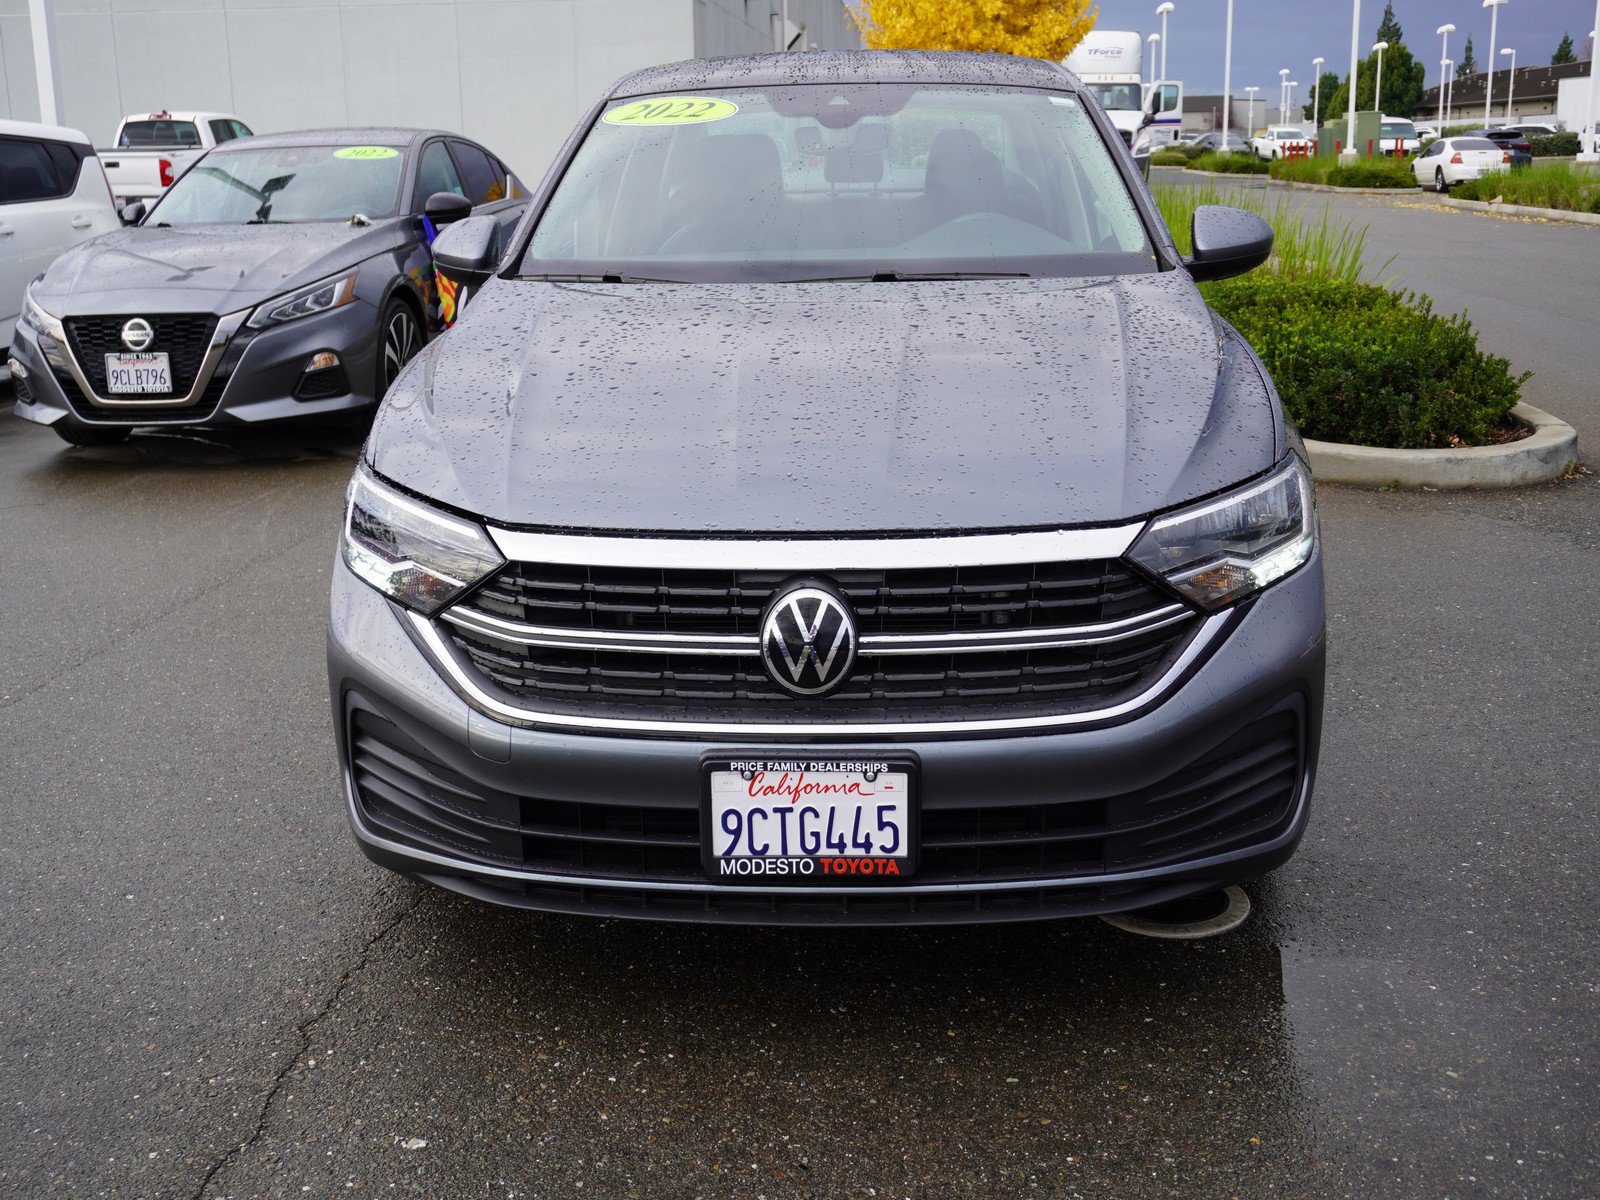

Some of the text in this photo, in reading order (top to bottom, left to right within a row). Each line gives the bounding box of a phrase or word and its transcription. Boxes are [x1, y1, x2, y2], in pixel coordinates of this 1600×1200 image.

[619, 102, 716, 120] 2022
[343, 149, 388, 157] 2022
[111, 368, 167, 386] 9CLB796
[111, 385, 169, 393] MODESTO TOYOTA
[730, 762, 889, 773] PRICE FAMILY DEALERSHIPS
[748, 772, 875, 804] California
[720, 804, 900, 857] 9CTG445
[720, 858, 900, 875] MODESTO TOYOTA
